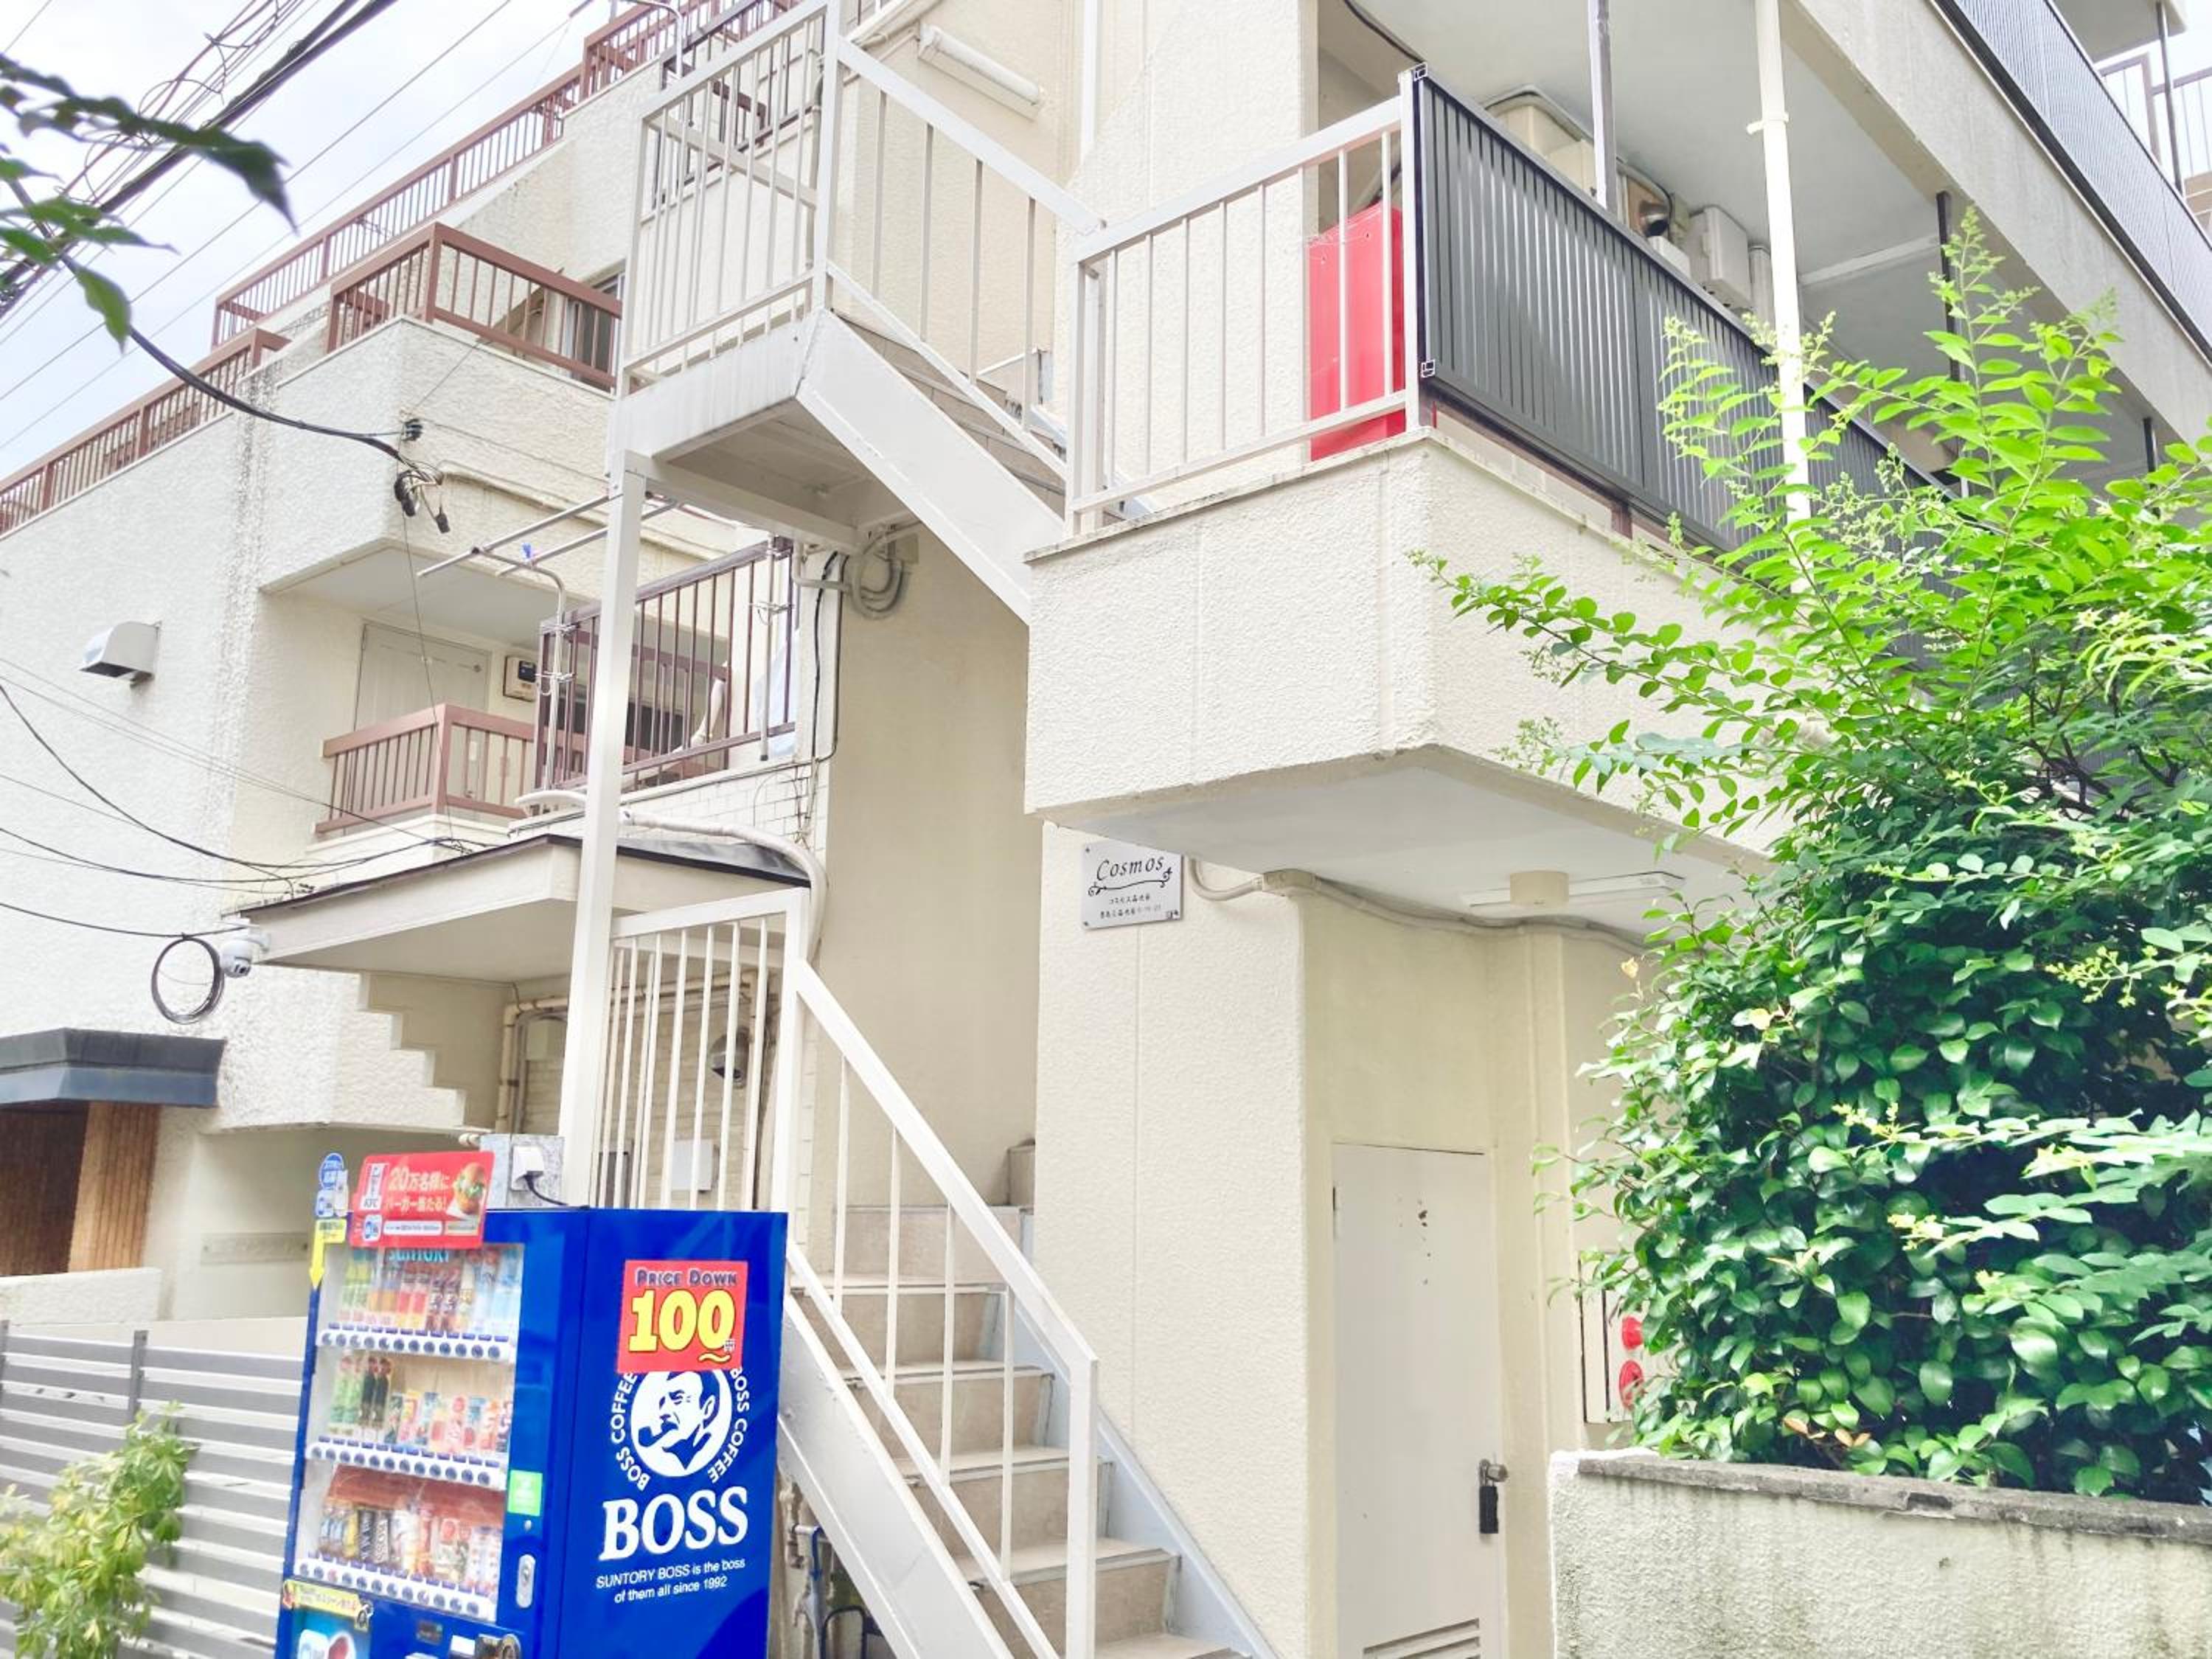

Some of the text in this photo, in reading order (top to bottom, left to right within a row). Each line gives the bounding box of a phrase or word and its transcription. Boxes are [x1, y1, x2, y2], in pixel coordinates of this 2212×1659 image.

[1096, 856, 1164, 881] Cosmos
[636, 1267, 738, 1287] PRICE DOWN
[628, 1289, 735, 1352] 100
[610, 1371, 651, 1492] BOSS COFFEE
[706, 1418, 748, 1484] COFFEE
[597, 1486, 748, 1562] BOSS
[595, 1558, 746, 1589] SUNTORY BOSS is the boss
[613, 1576, 728, 1604] of them all since 1992
